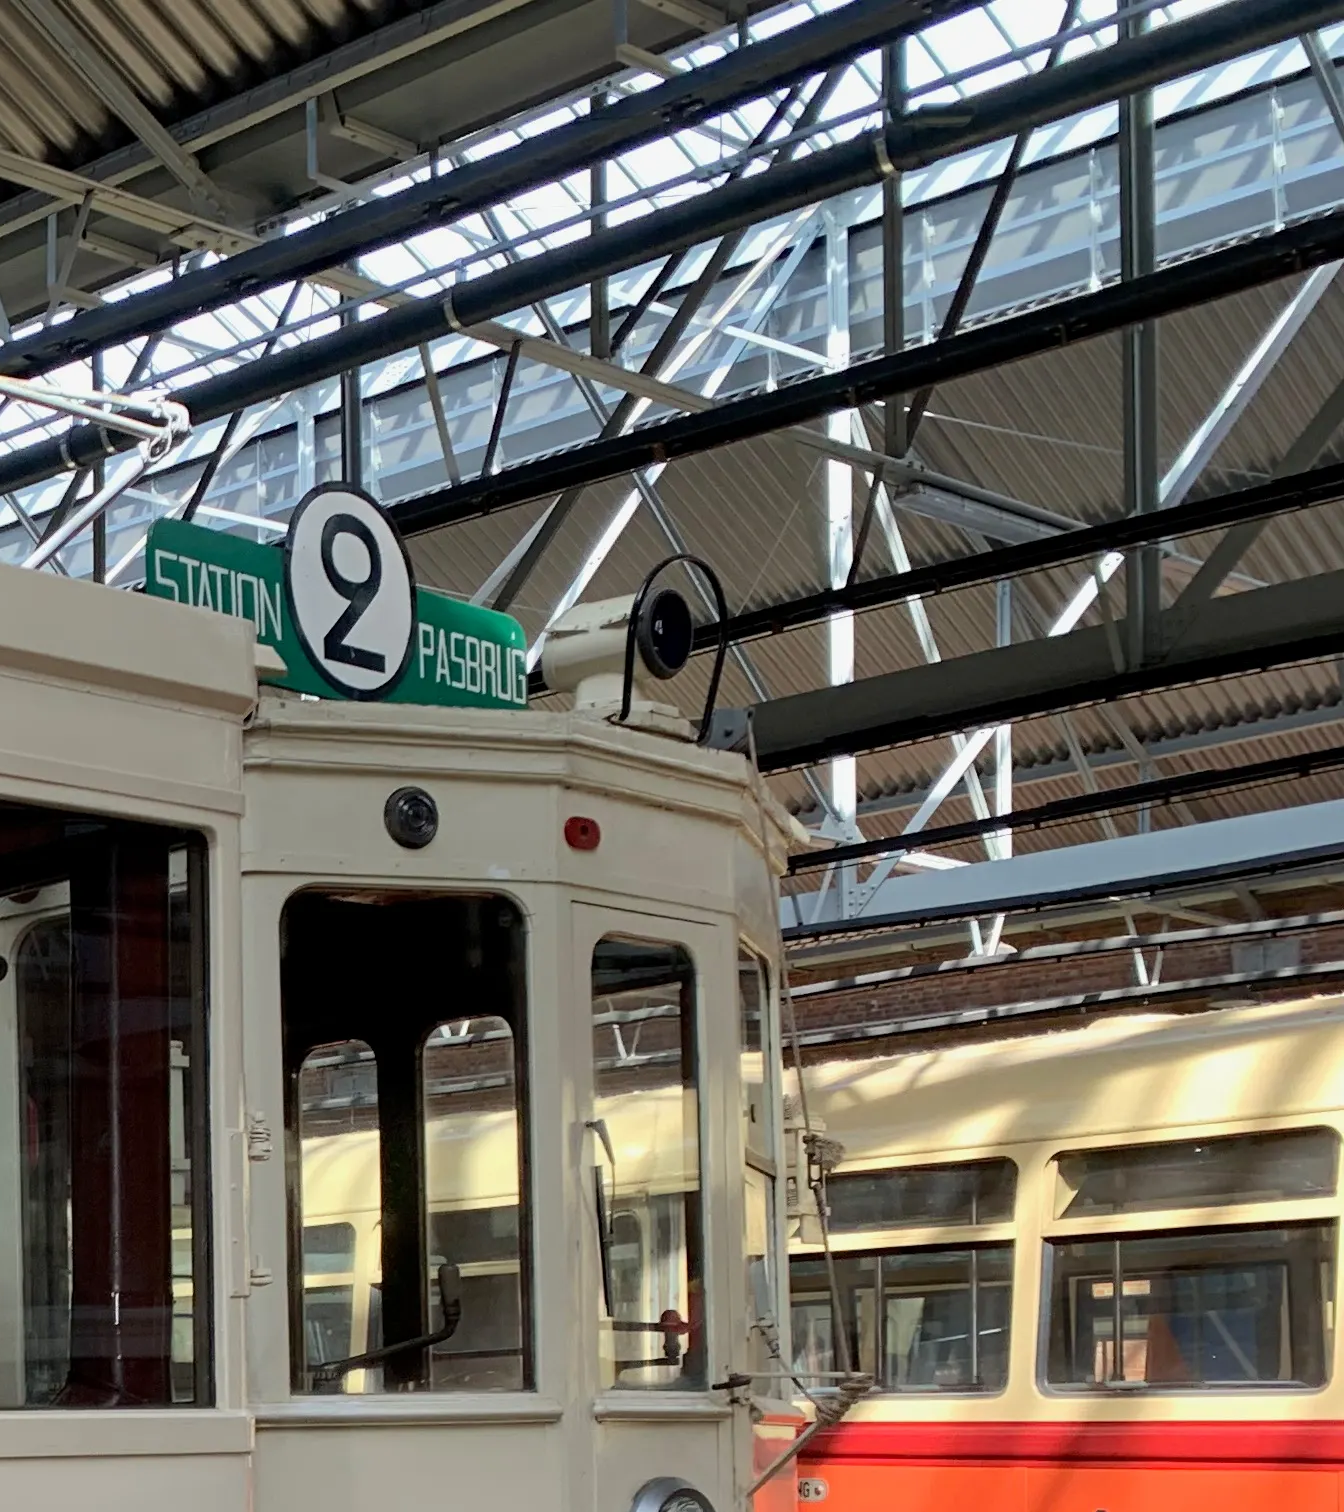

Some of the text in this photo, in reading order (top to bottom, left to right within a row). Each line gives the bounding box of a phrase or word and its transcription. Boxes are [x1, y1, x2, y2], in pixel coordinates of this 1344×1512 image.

[153, 548, 283, 641] STATION
[320, 512, 386, 674] 2
[418, 621, 528, 706] PASBRUG
